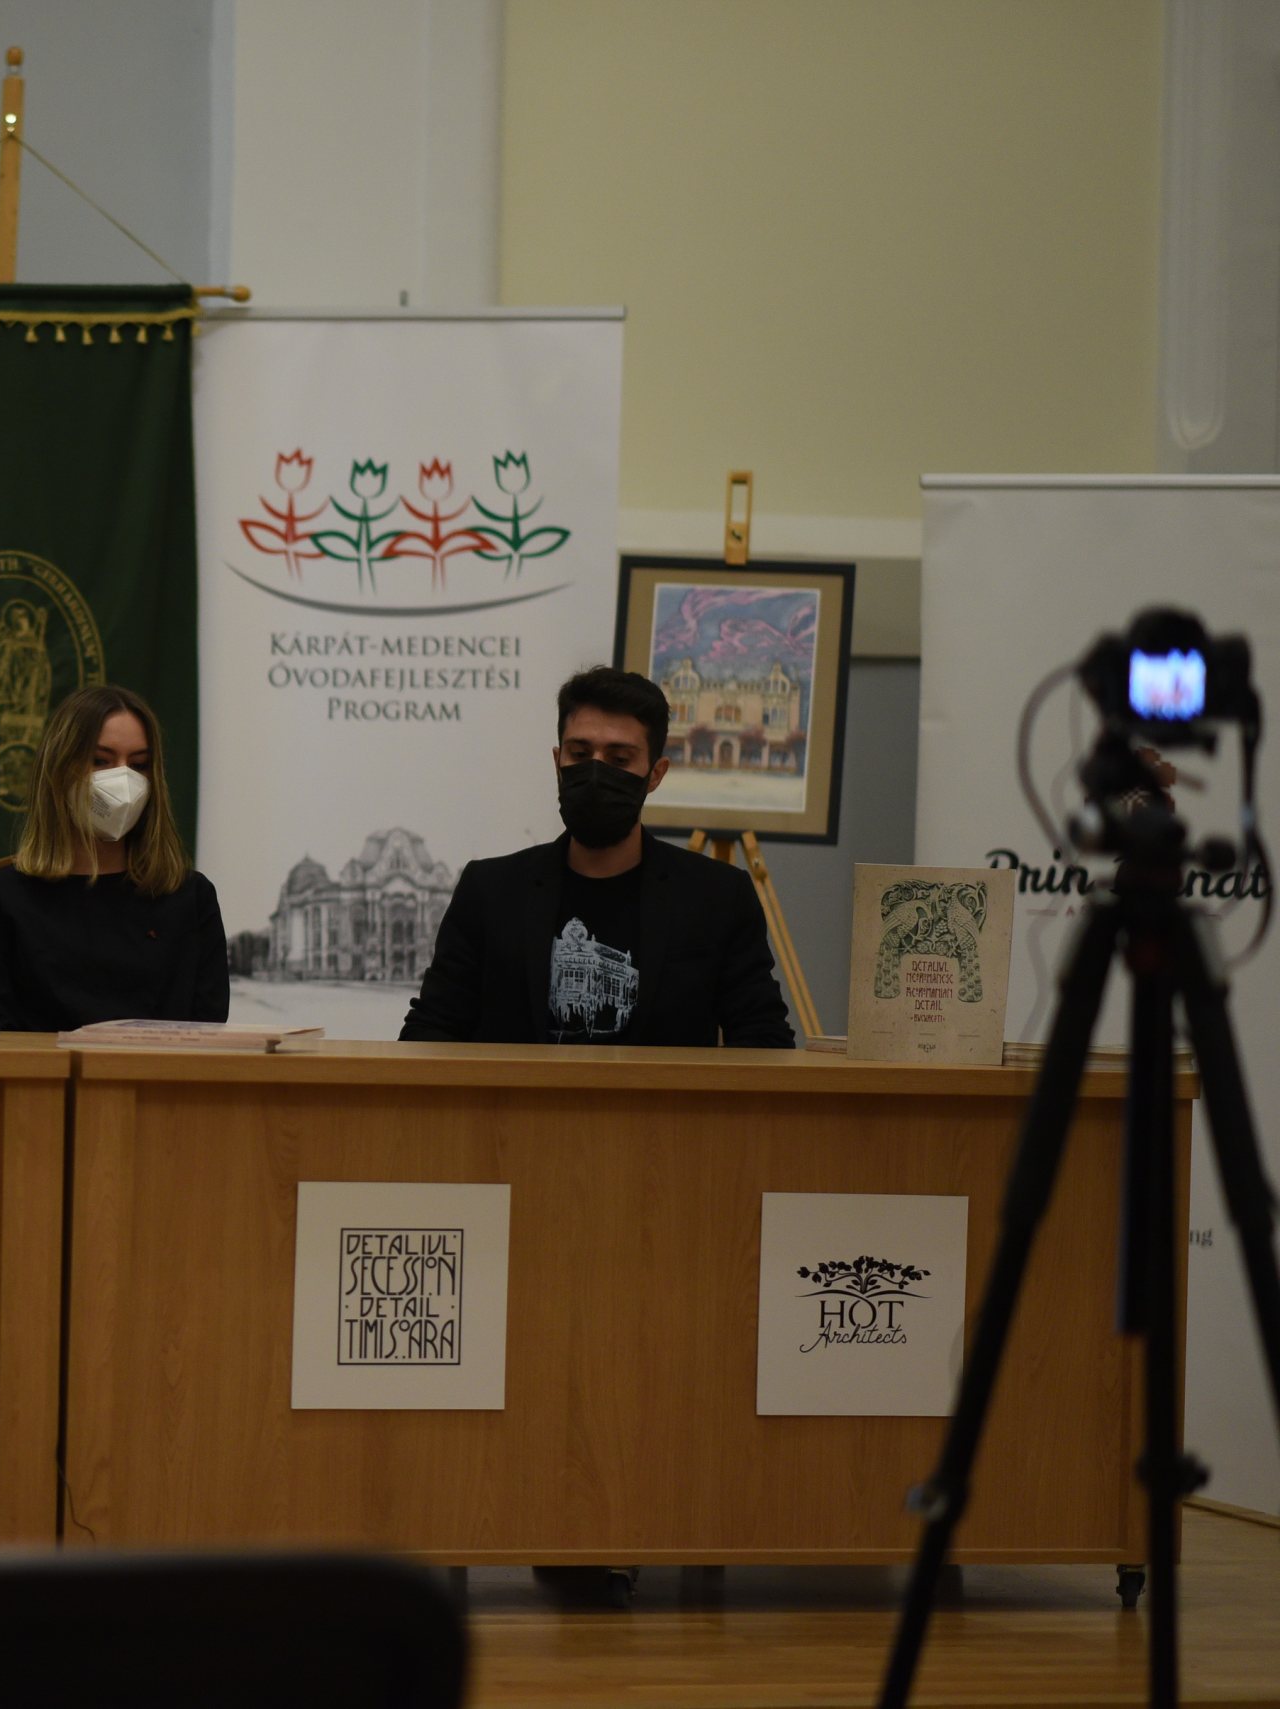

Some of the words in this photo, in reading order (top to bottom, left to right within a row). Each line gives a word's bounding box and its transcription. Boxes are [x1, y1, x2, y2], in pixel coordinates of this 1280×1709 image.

[269, 631, 521, 657] KÁRPÁT-MEDENCEI
[268, 661, 521, 690] ÓVODAFEJLESZTÉSI
[327, 697, 462, 721] PROGRAM
[346, 1256, 455, 1295] SECESSION
[360, 1297, 439, 1317] DETAIL
[820, 1300, 904, 1329] HOT
[800, 1320, 907, 1353] Architects
